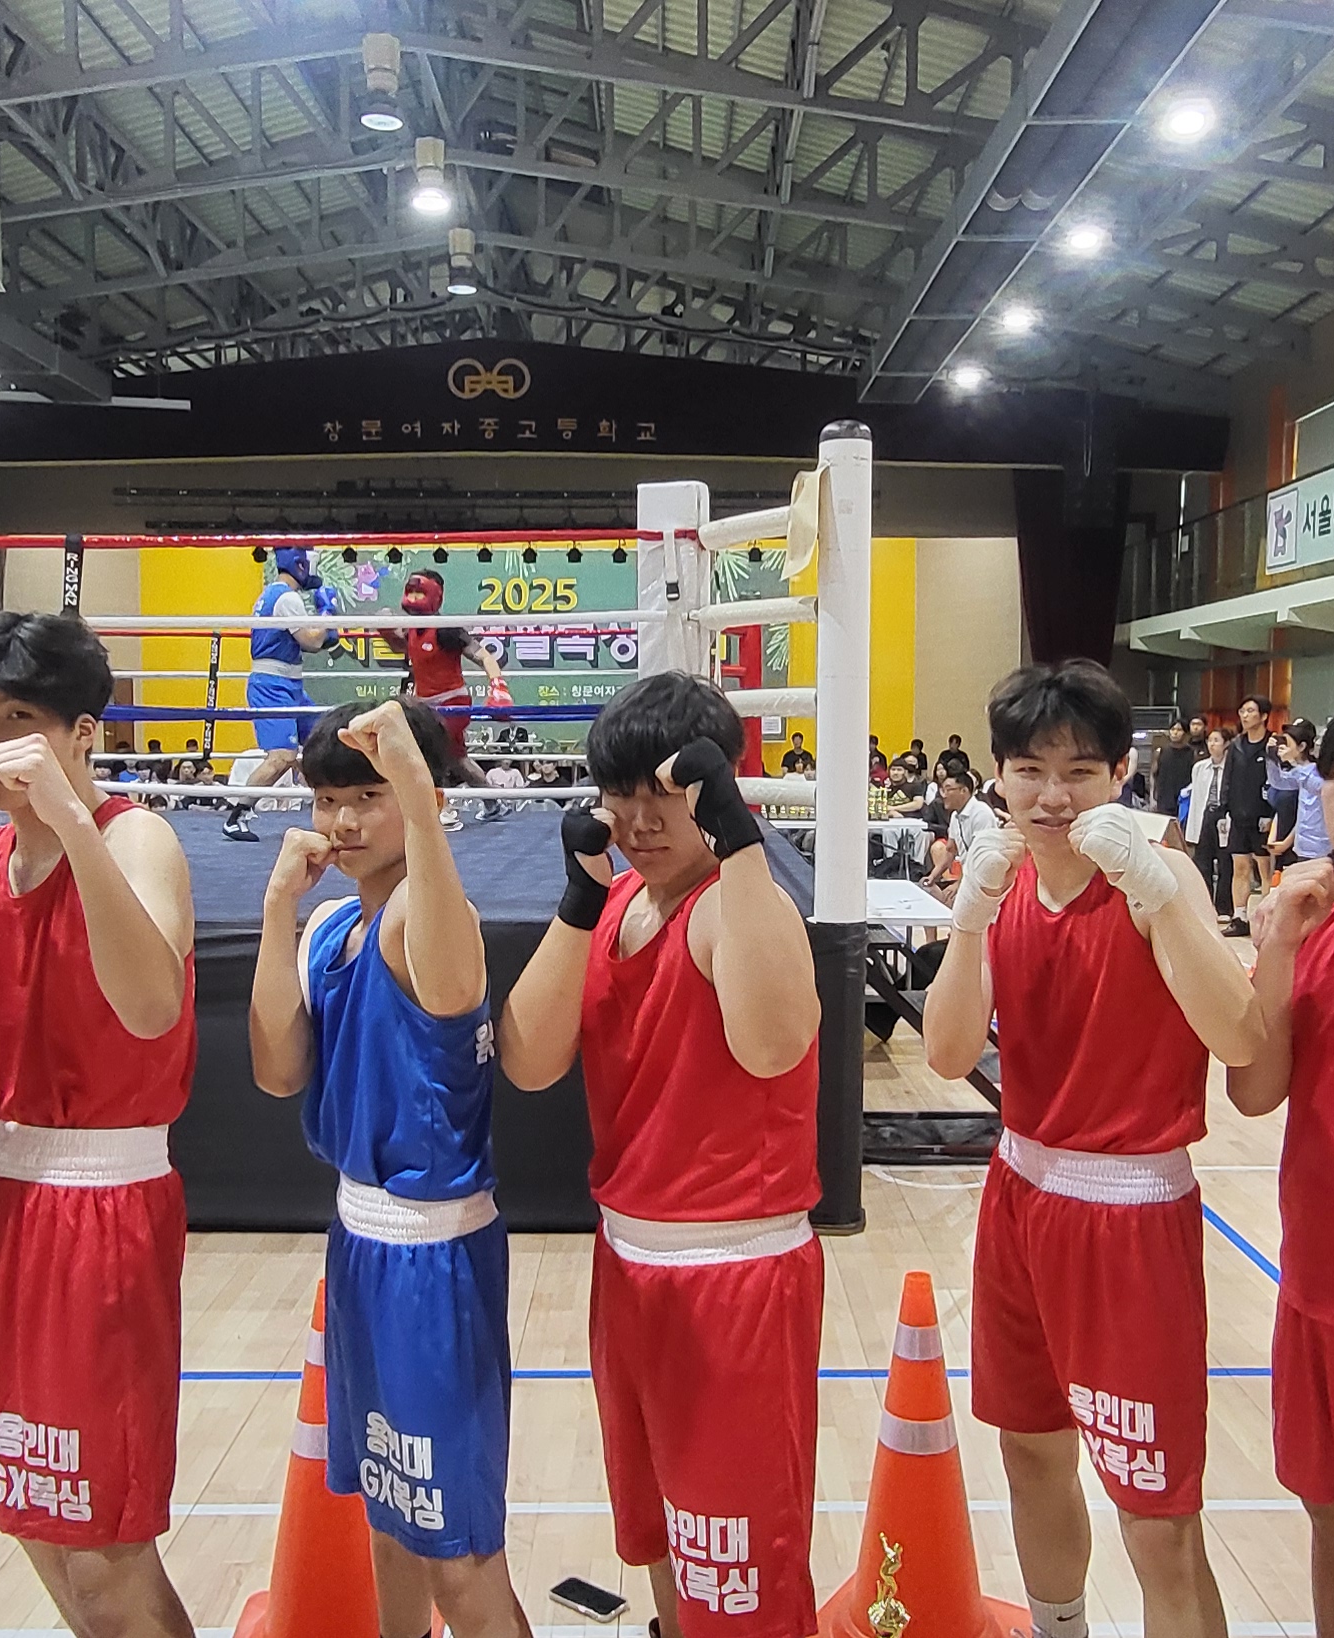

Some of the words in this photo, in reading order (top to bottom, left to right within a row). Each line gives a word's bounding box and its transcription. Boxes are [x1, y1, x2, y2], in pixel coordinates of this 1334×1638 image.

[64, 552, 79, 606] RINGMAN
[479, 577, 579, 613] 2025
[571, 684, 623, 698] 창문여자
[1068, 1382, 1156, 1443] 용인대
[366, 1411, 433, 1481] 용인대
[1076, 1425, 1167, 1492] X복싱
[359, 1457, 445, 1531] GX복싱
[669, 1550, 760, 1616] X복싱
